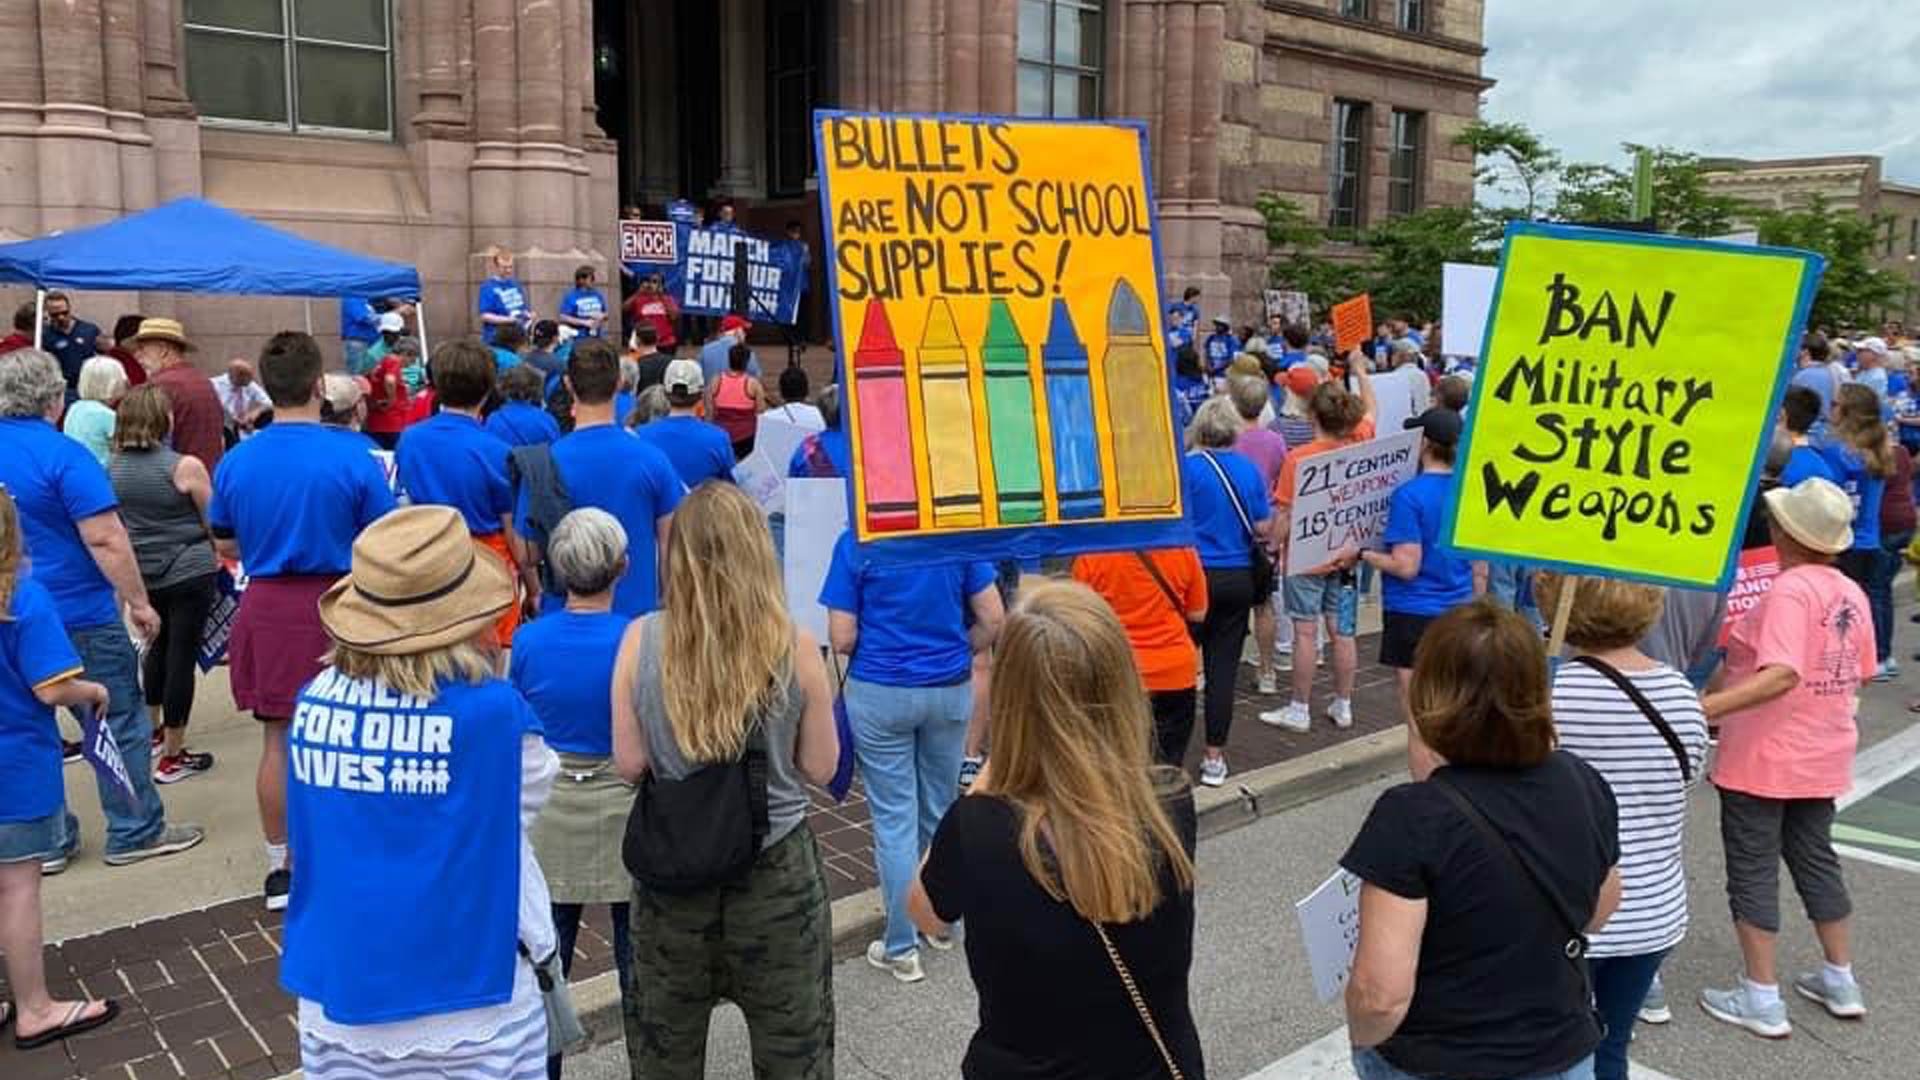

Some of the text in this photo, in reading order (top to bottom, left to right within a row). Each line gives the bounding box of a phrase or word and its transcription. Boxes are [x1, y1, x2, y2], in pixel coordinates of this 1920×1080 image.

[831, 117, 1019, 174] BULLETS
[838, 177, 1150, 237] ARE NOT SCHOOL
[623, 230, 673, 256] ENOCH
[687, 256, 736, 284] FOR
[837, 239, 1072, 300] SUPPLIES!
[1537, 273, 1676, 348] BAN
[1494, 354, 1713, 426] Military
[1328, 470, 1399, 505] WEAPONS
[1345, 446, 1411, 479] CENTURY
[1482, 461, 1715, 541] Weapons
[292, 702, 453, 753] FOR OUR
[291, 744, 385, 793] LIVES
